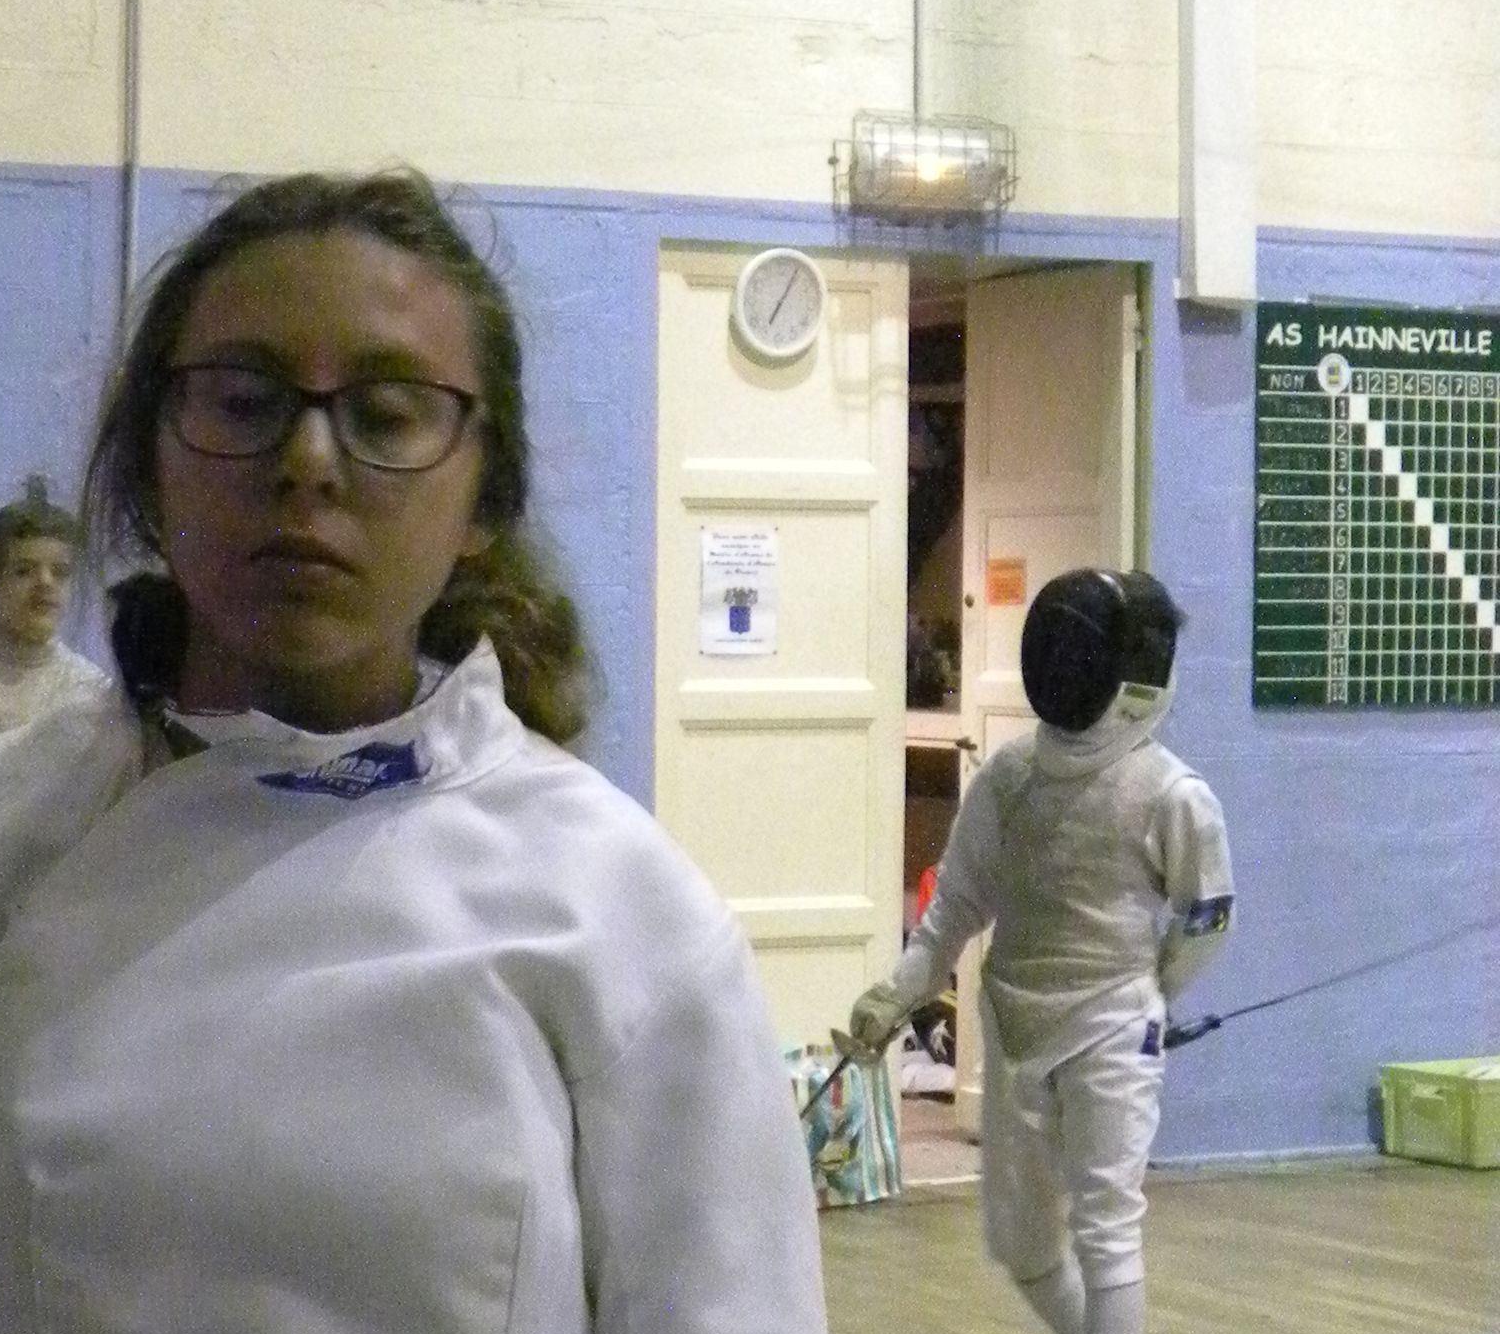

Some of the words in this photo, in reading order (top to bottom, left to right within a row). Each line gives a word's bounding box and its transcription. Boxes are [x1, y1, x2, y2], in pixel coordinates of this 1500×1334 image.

[1266, 323, 1303, 347] AS
[1318, 324, 1493, 356] HAINNEVILLE
[1269, 373, 1307, 390] NOM
[1354, 375, 1365, 392] 1
[1369, 375, 1383, 394] 2
[1385, 376, 1399, 394] 3
[1403, 377, 1416, 393] 4
[1420, 377, 1432, 394] 5
[1437, 377, 1448, 395] 6
[1452, 378, 1464, 395] 7
[1468, 377, 1480, 396] 8
[1484, 378, 1495, 396] 9
[1336, 425, 1348, 443] 2
[1338, 451, 1348, 469] 3
[1336, 503, 1347, 520] 5
[1336, 527, 1347, 547] 6
[1336, 553, 1346, 571] 7
[1335, 579, 1346, 599] 8
[1334, 605, 1346, 624] 9
